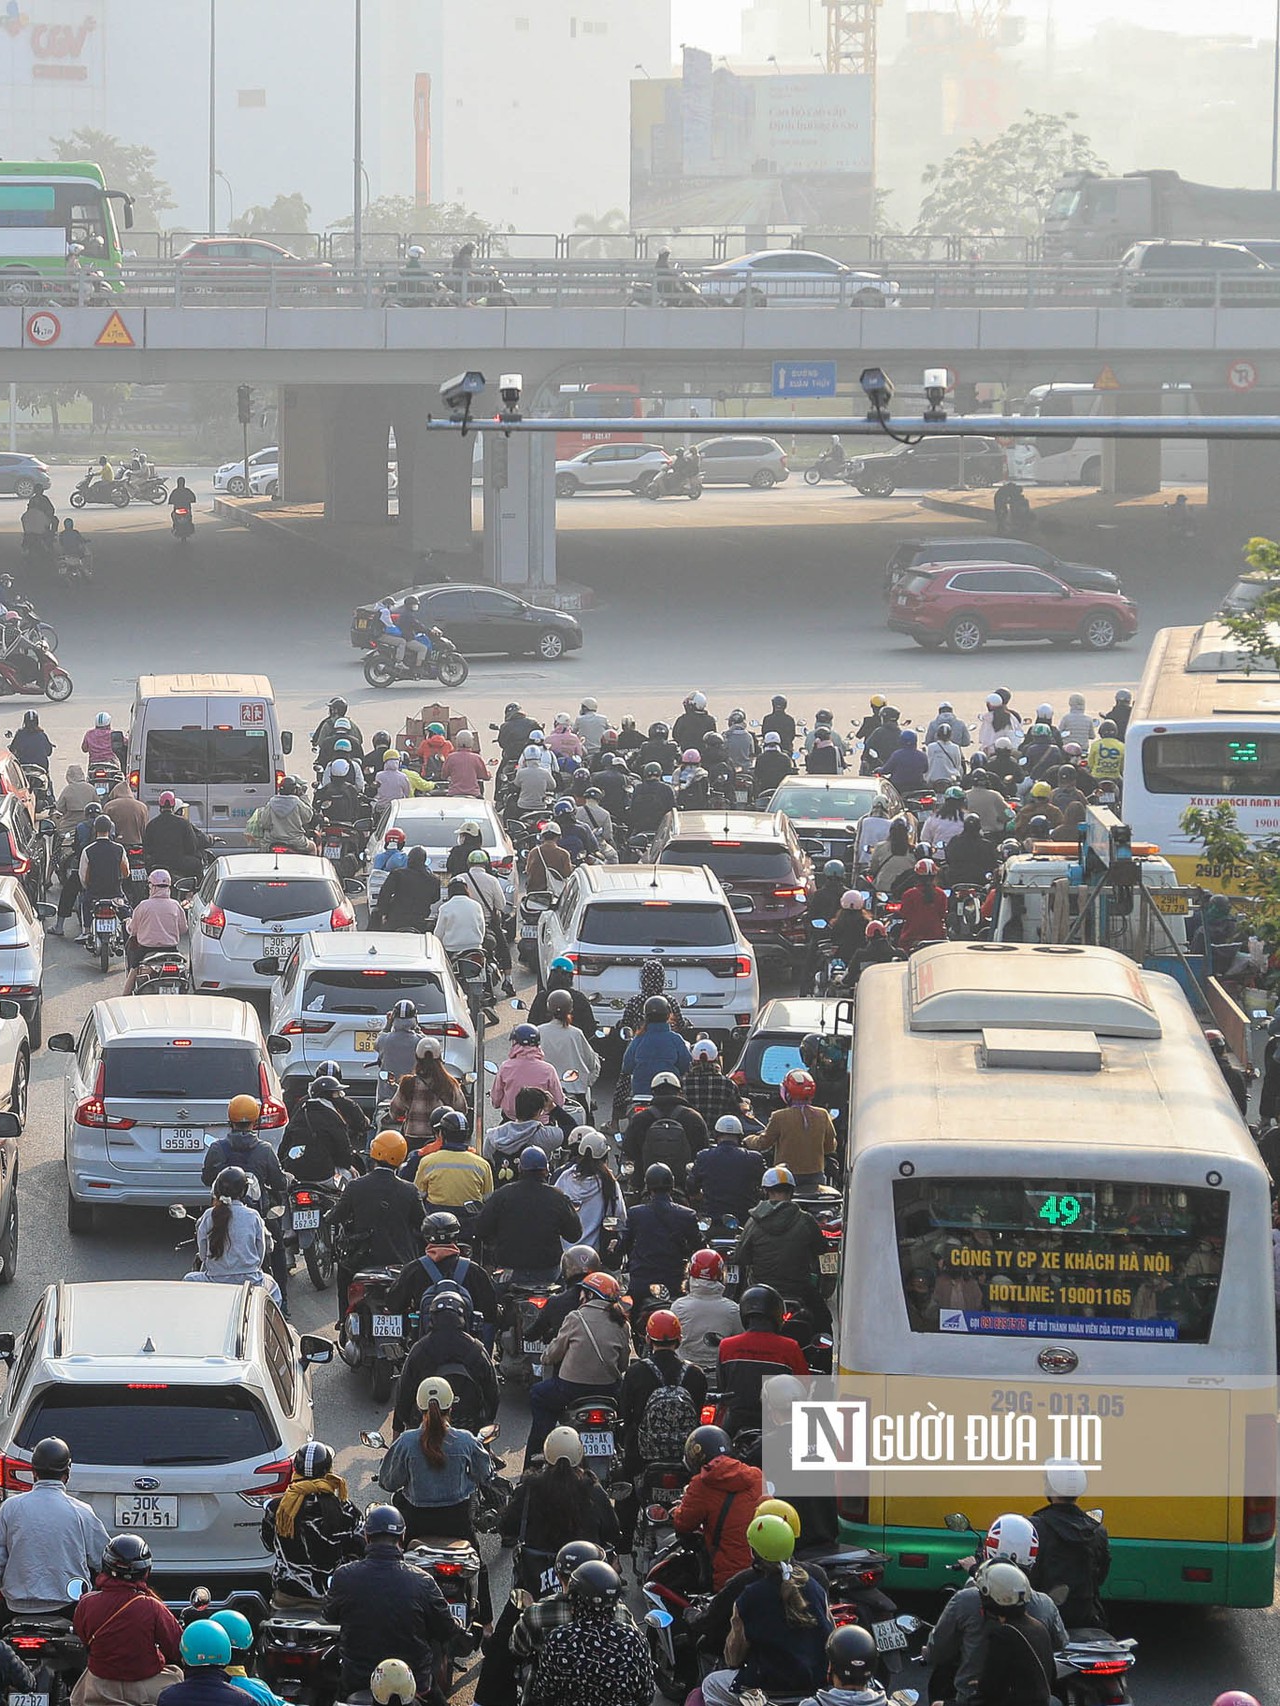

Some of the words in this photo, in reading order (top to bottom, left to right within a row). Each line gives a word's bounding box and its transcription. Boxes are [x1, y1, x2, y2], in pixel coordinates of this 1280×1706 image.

[1098, 743, 1120, 760] be
[172, 1129, 192, 1139] 30G
[165, 1139, 200, 1149] 959.39
[1039, 1195, 1081, 1226] 49
[950, 1247, 991, 1268] CÔNG
[996, 1250, 1013, 1268] TY
[1016, 1251, 1037, 1269] CP
[1041, 1252, 1061, 1269] XE
[1065, 1250, 1115, 1272] KHÁCH
[1119, 1251, 1139, 1272] HÀ
[1143, 1252, 1171, 1276] NỘI
[988, 1283, 1055, 1303] HOTLINE:
[1059, 1286, 1132, 1307] 19001165
[374, 1325, 401, 1336] 026.40
[990, 1389, 1032, 1413] 29G
[1049, 1392, 1126, 1418] 013.05
[133, 1498, 160, 1510] 30K
[121, 1511, 170, 1526] 671.51
